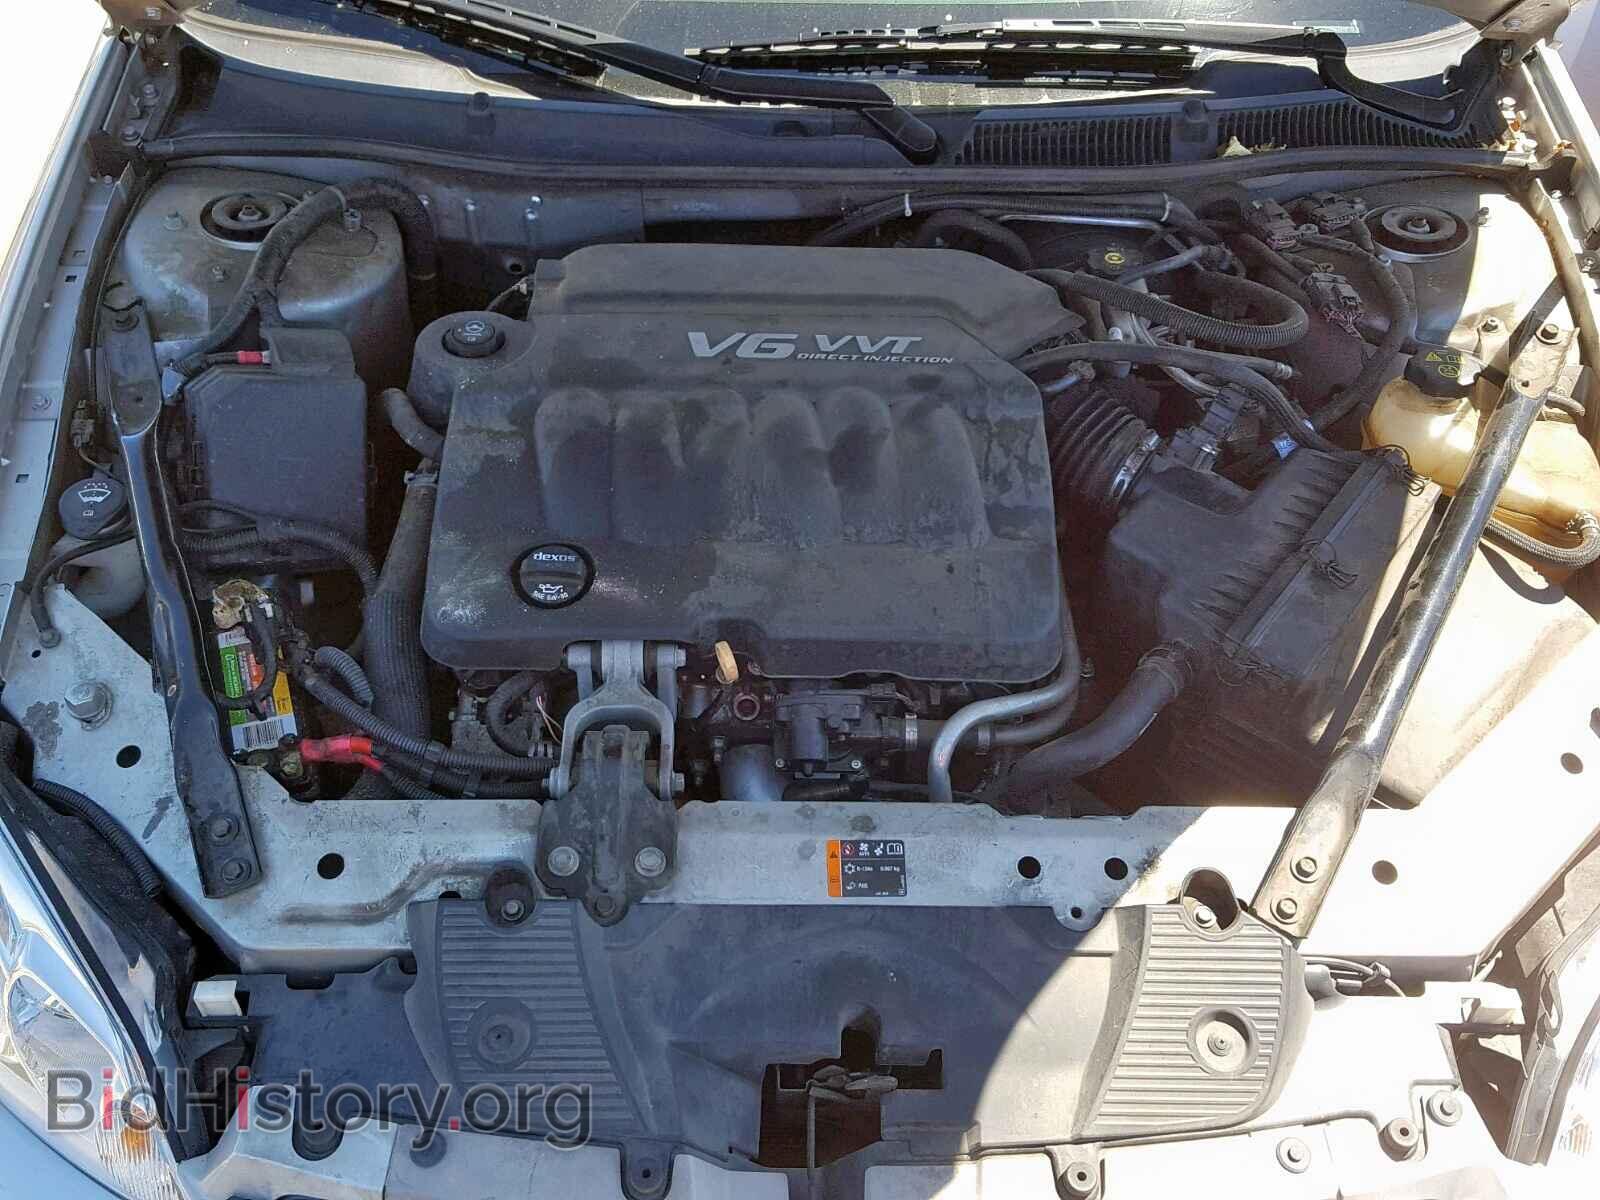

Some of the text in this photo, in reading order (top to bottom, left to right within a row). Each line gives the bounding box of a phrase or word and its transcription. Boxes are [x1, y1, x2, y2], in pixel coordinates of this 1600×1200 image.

[687, 331, 923, 359] V6 VVT
[796, 352, 954, 364] DIRECT INJECTION
[533, 552, 577, 562] dexos
